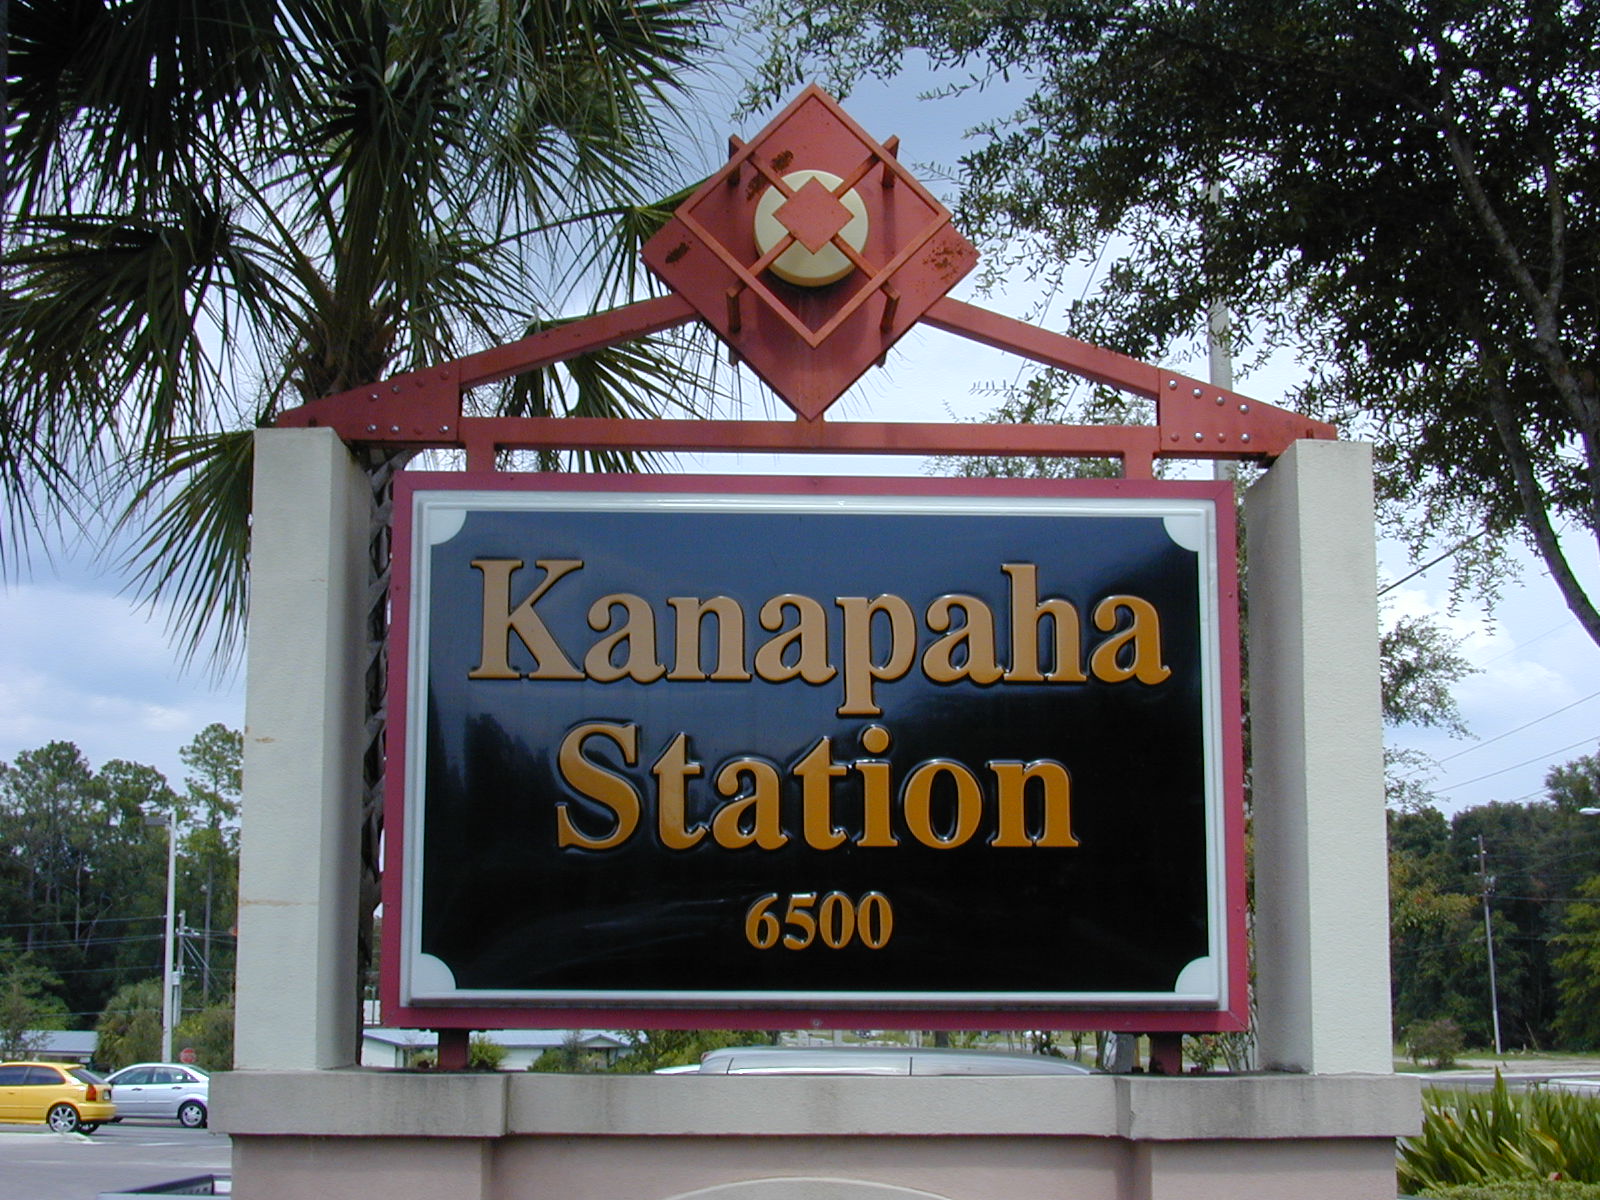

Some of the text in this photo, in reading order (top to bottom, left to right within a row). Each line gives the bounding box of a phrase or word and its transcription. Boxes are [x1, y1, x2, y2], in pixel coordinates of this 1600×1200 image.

[469, 557, 1173, 717] Kanapaha
[556, 722, 1081, 851] Station
[744, 891, 895, 952] 6500
